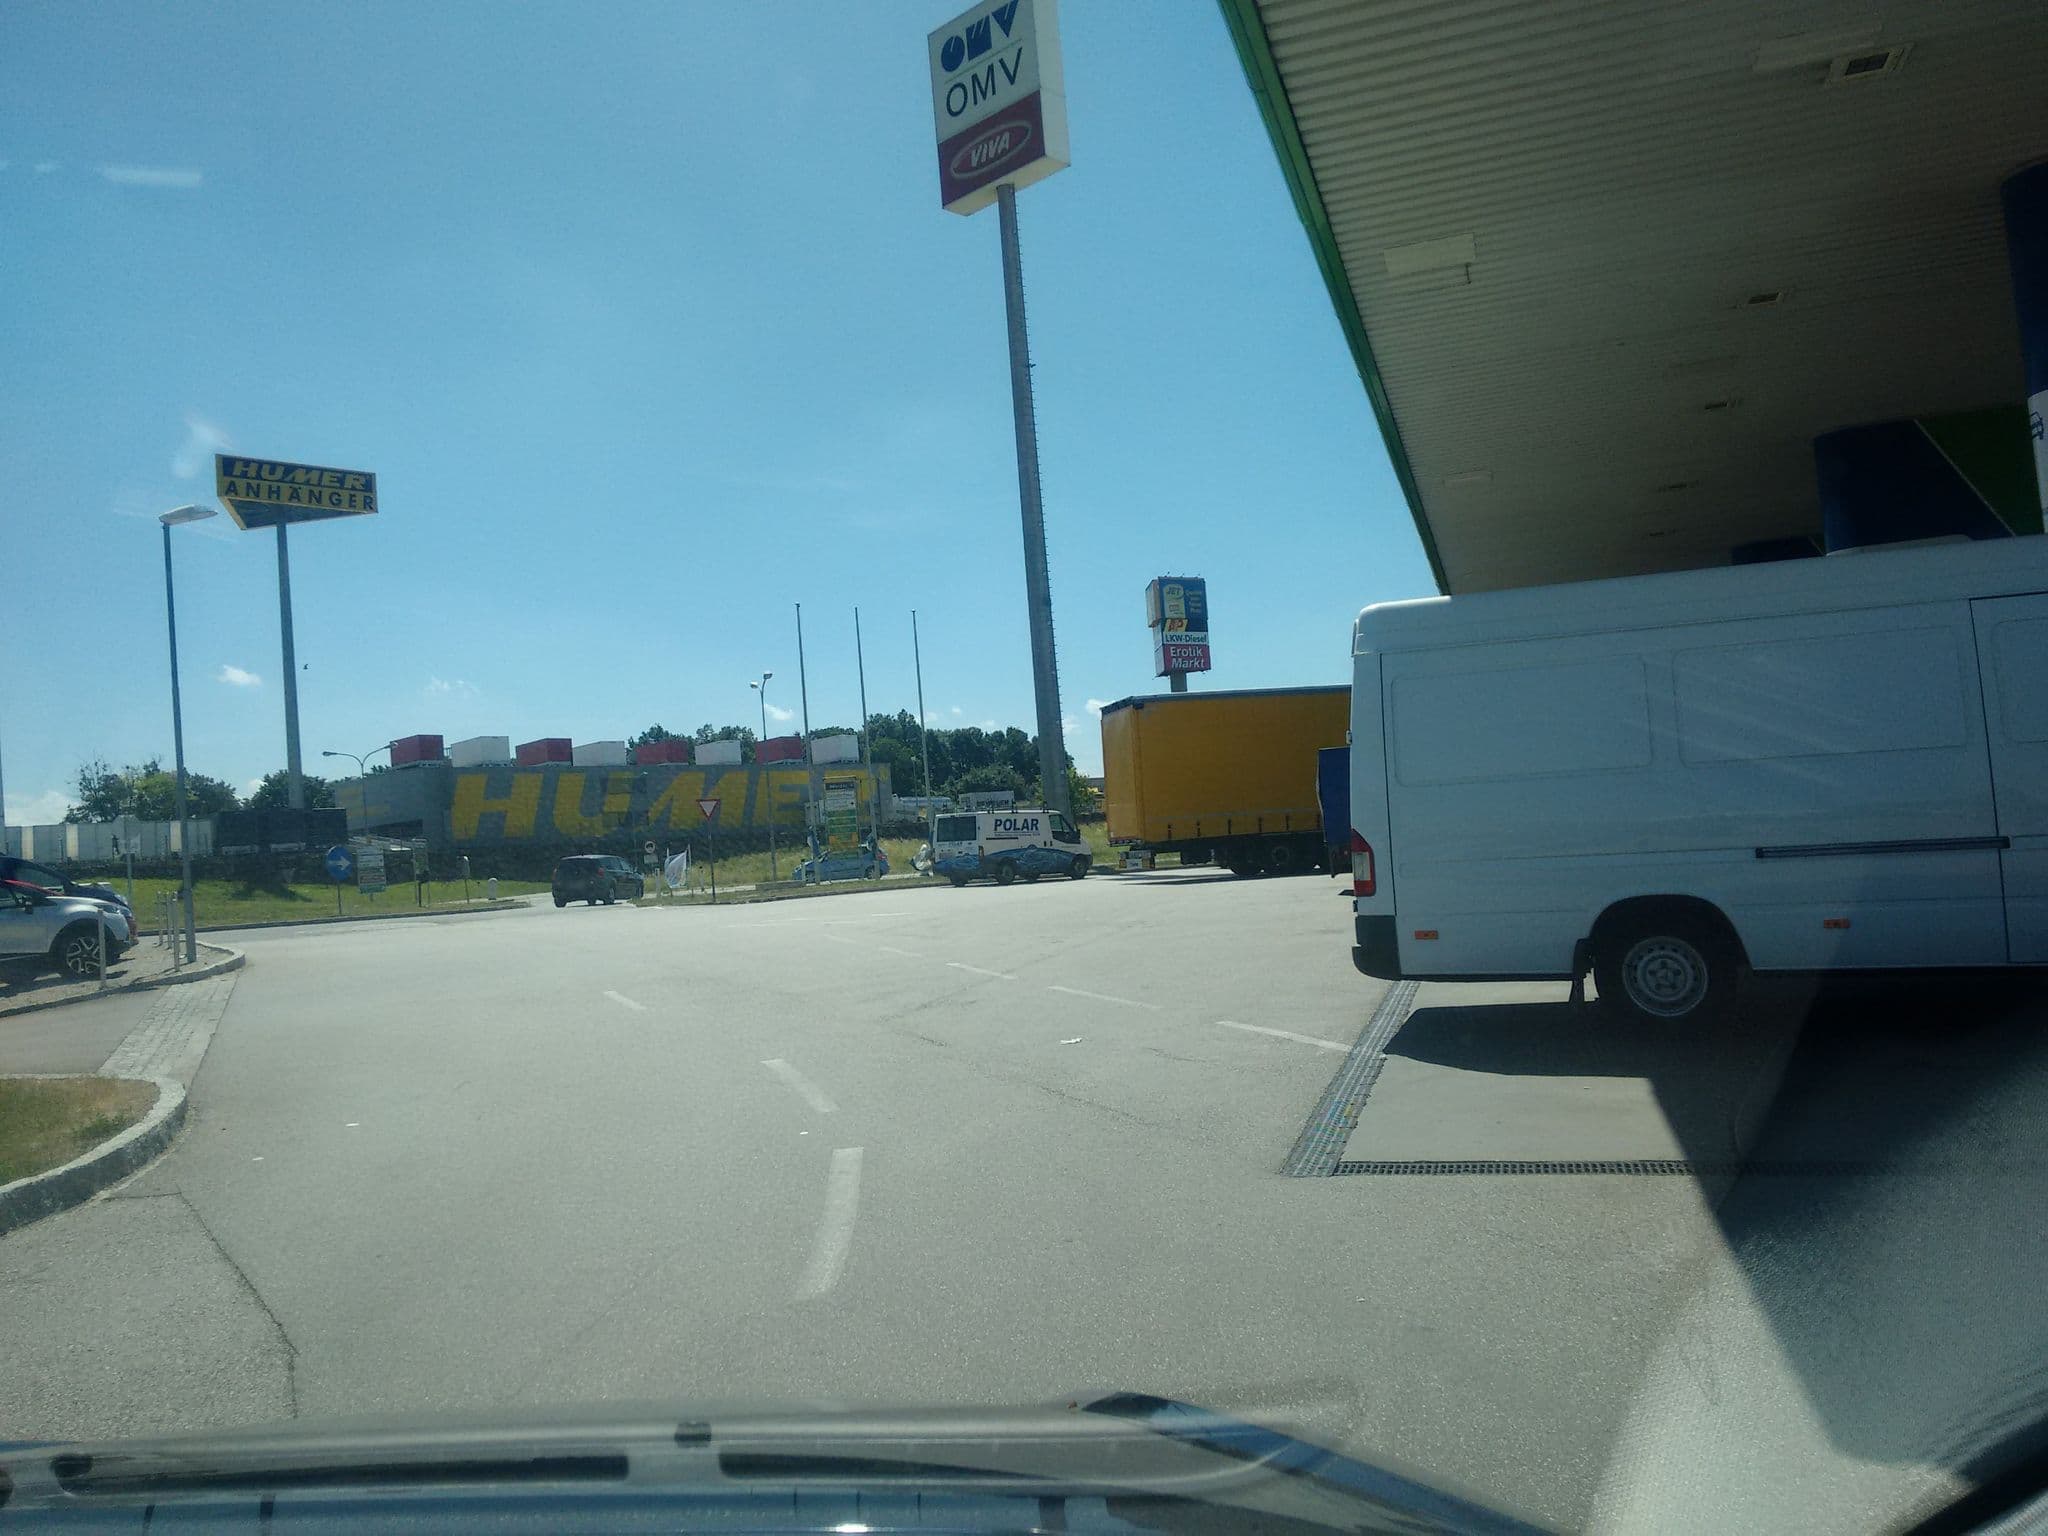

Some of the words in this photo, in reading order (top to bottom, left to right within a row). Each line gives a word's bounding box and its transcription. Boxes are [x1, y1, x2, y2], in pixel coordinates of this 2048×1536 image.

[946, 47, 1023, 117] OMV
[971, 131, 1010, 168] VIVA
[232, 460, 367, 490] HUMER
[225, 480, 374, 511] ANHÄNGER
[1165, 633, 1207, 643] LKW-Diesel
[1170, 646, 1203, 657] Erotik
[1171, 657, 1205, 669] Markt
[994, 818, 1039, 831] POLAR
